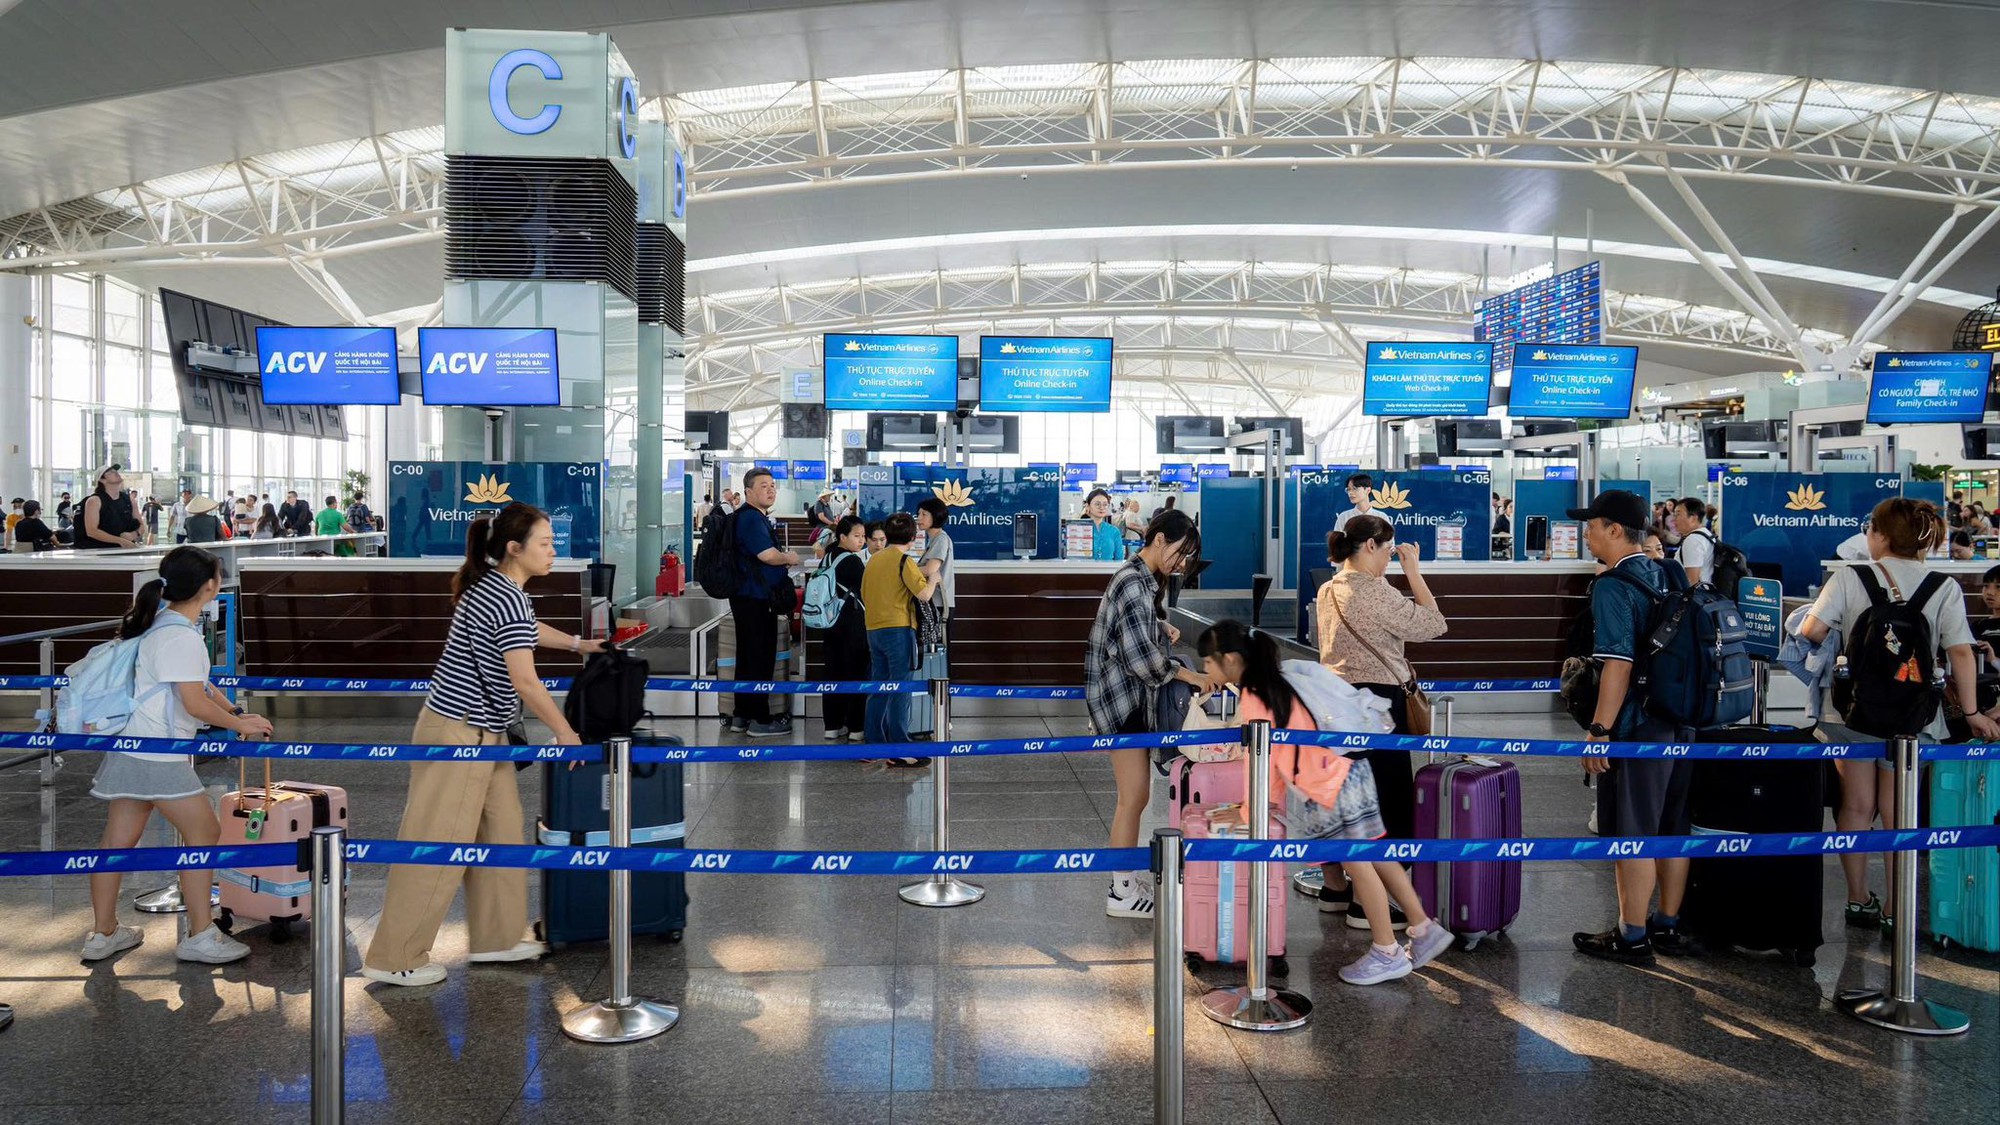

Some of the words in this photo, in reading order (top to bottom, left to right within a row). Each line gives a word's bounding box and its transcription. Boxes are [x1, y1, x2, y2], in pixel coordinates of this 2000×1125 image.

[488, 48, 562, 136] C
[620, 77, 637, 160] C
[860, 343, 895, 352] Vietnam
[895, 344, 926, 353] Airlines
[1016, 345, 1050, 354] Vietnam
[1051, 346, 1081, 354] Airlines
[368, 350, 390, 358] KHÔNG
[529, 351, 550, 359] KHÔNG
[1397, 350, 1436, 360] Vietnam
[1436, 350, 1472, 360] Airlines
[1547, 353, 1579, 361] Vietnam
[1579, 353, 1608, 362] Airlines
[265, 351, 327, 374] ACV
[334, 358, 351, 366] QUỐC
[426, 352, 488, 374] ACV
[495, 359, 511, 367] QUỐC
[1900, 359, 1929, 367] Vietnam
[847, 365, 865, 375] THỦ
[866, 367, 883, 376] TỤC
[907, 365, 935, 376] TUYẾN
[1002, 366, 1020, 377] THỦ
[1021, 368, 1039, 378] TỤC
[1063, 367, 1090, 377] TUYẾN
[859, 377, 887, 387] Online
[888, 378, 923, 387] Check-in
[1372, 374, 1396, 382] KHÁCH
[1413, 373, 1427, 382] THỦ
[1427, 375, 1441, 383] TỤC
[1442, 375, 1460, 383] TRỰC
[1461, 374, 1484, 383] TUYẾN
[1532, 373, 1549, 383] THỦ
[1550, 374, 1565, 384] TỤC
[1588, 374, 1614, 384] TUYẾN
[793, 373, 812, 398] E
[1014, 380, 1041, 388] Online
[1041, 380, 1077, 388] Check-in
[1404, 384, 1420, 392] Web
[1420, 384, 1450, 392] Check-in
[1541, 386, 1568, 394] Online
[1568, 386, 1601, 395] Check-in
[1879, 387, 1889, 398] CÓ
[1962, 387, 1979, 398] NHỎ
[1896, 399, 1922, 409] Family
[1923, 399, 1958, 408] Check-in
[1842, 453, 1868, 461] HECK
[392, 464, 424, 476] C-00
[567, 465, 597, 477] C-01
[860, 470, 889, 482] C-02
[1302, 474, 1329, 485] C-04
[1462, 474, 1490, 485] C-05
[1723, 476, 1748, 487] C-06
[1875, 478, 1900, 489] C-07
[428, 507, 475, 521] Vietna
[958, 510, 1013, 526] Airlines
[1394, 512, 1446, 526] Airlines
[1753, 513, 1808, 527] Vietnam
[1811, 513, 1859, 527] Airlines
[1755, 613, 1770, 622] LÒNG
[1745, 620, 1753, 629] HỜ
[53, 677, 70, 687] AC
[410, 681, 431, 690] ACV
[540, 679, 559, 689] CV
[691, 682, 712, 691] ACV
[817, 683, 838, 692] ACV
[1473, 682, 1493, 690] ACV
[1531, 681, 1551, 689] ACV
[949, 686, 960, 695] CV
[27, 736, 55, 745] ACV
[113, 739, 141, 749] ACV
[199, 743, 227, 752] ACV
[284, 745, 312, 754] ACV
[369, 747, 396, 756] ACV
[453, 748, 481, 757] ACV
[537, 748, 564, 757] ACV
[951, 745, 972, 753] ACV
[1024, 742, 1044, 750] ACV
[1093, 738, 1113, 747] ACV
[1272, 731, 1290, 742] CV
[1343, 736, 1369, 745] ACV
[1423, 739, 1449, 748] ACV
[1503, 742, 1529, 751] ACV
[1583, 745, 1609, 754] ACV
[1663, 746, 1689, 755] ACV
[1743, 747, 1769, 755] ACV
[1823, 746, 1848, 755] ACV
[1270, 844, 1308, 857] ACV
[1385, 844, 1422, 857] ACV
[1497, 843, 1534, 856] ACV
[1608, 842, 1644, 854] ACV
[1716, 839, 1751, 852] ACV
[1823, 836, 1857, 849] ACV
[1927, 831, 1960, 844] ACV
[65, 856, 98, 868] ACV
[177, 852, 209, 864] ACV
[341, 844, 370, 859] CV
[450, 848, 489, 862] ACV
[570, 851, 609, 865] ACV
[691, 854, 731, 868] ACV
[812, 856, 852, 869] ACV
[933, 856, 973, 869] ACV
[1055, 854, 1094, 868] ACV
